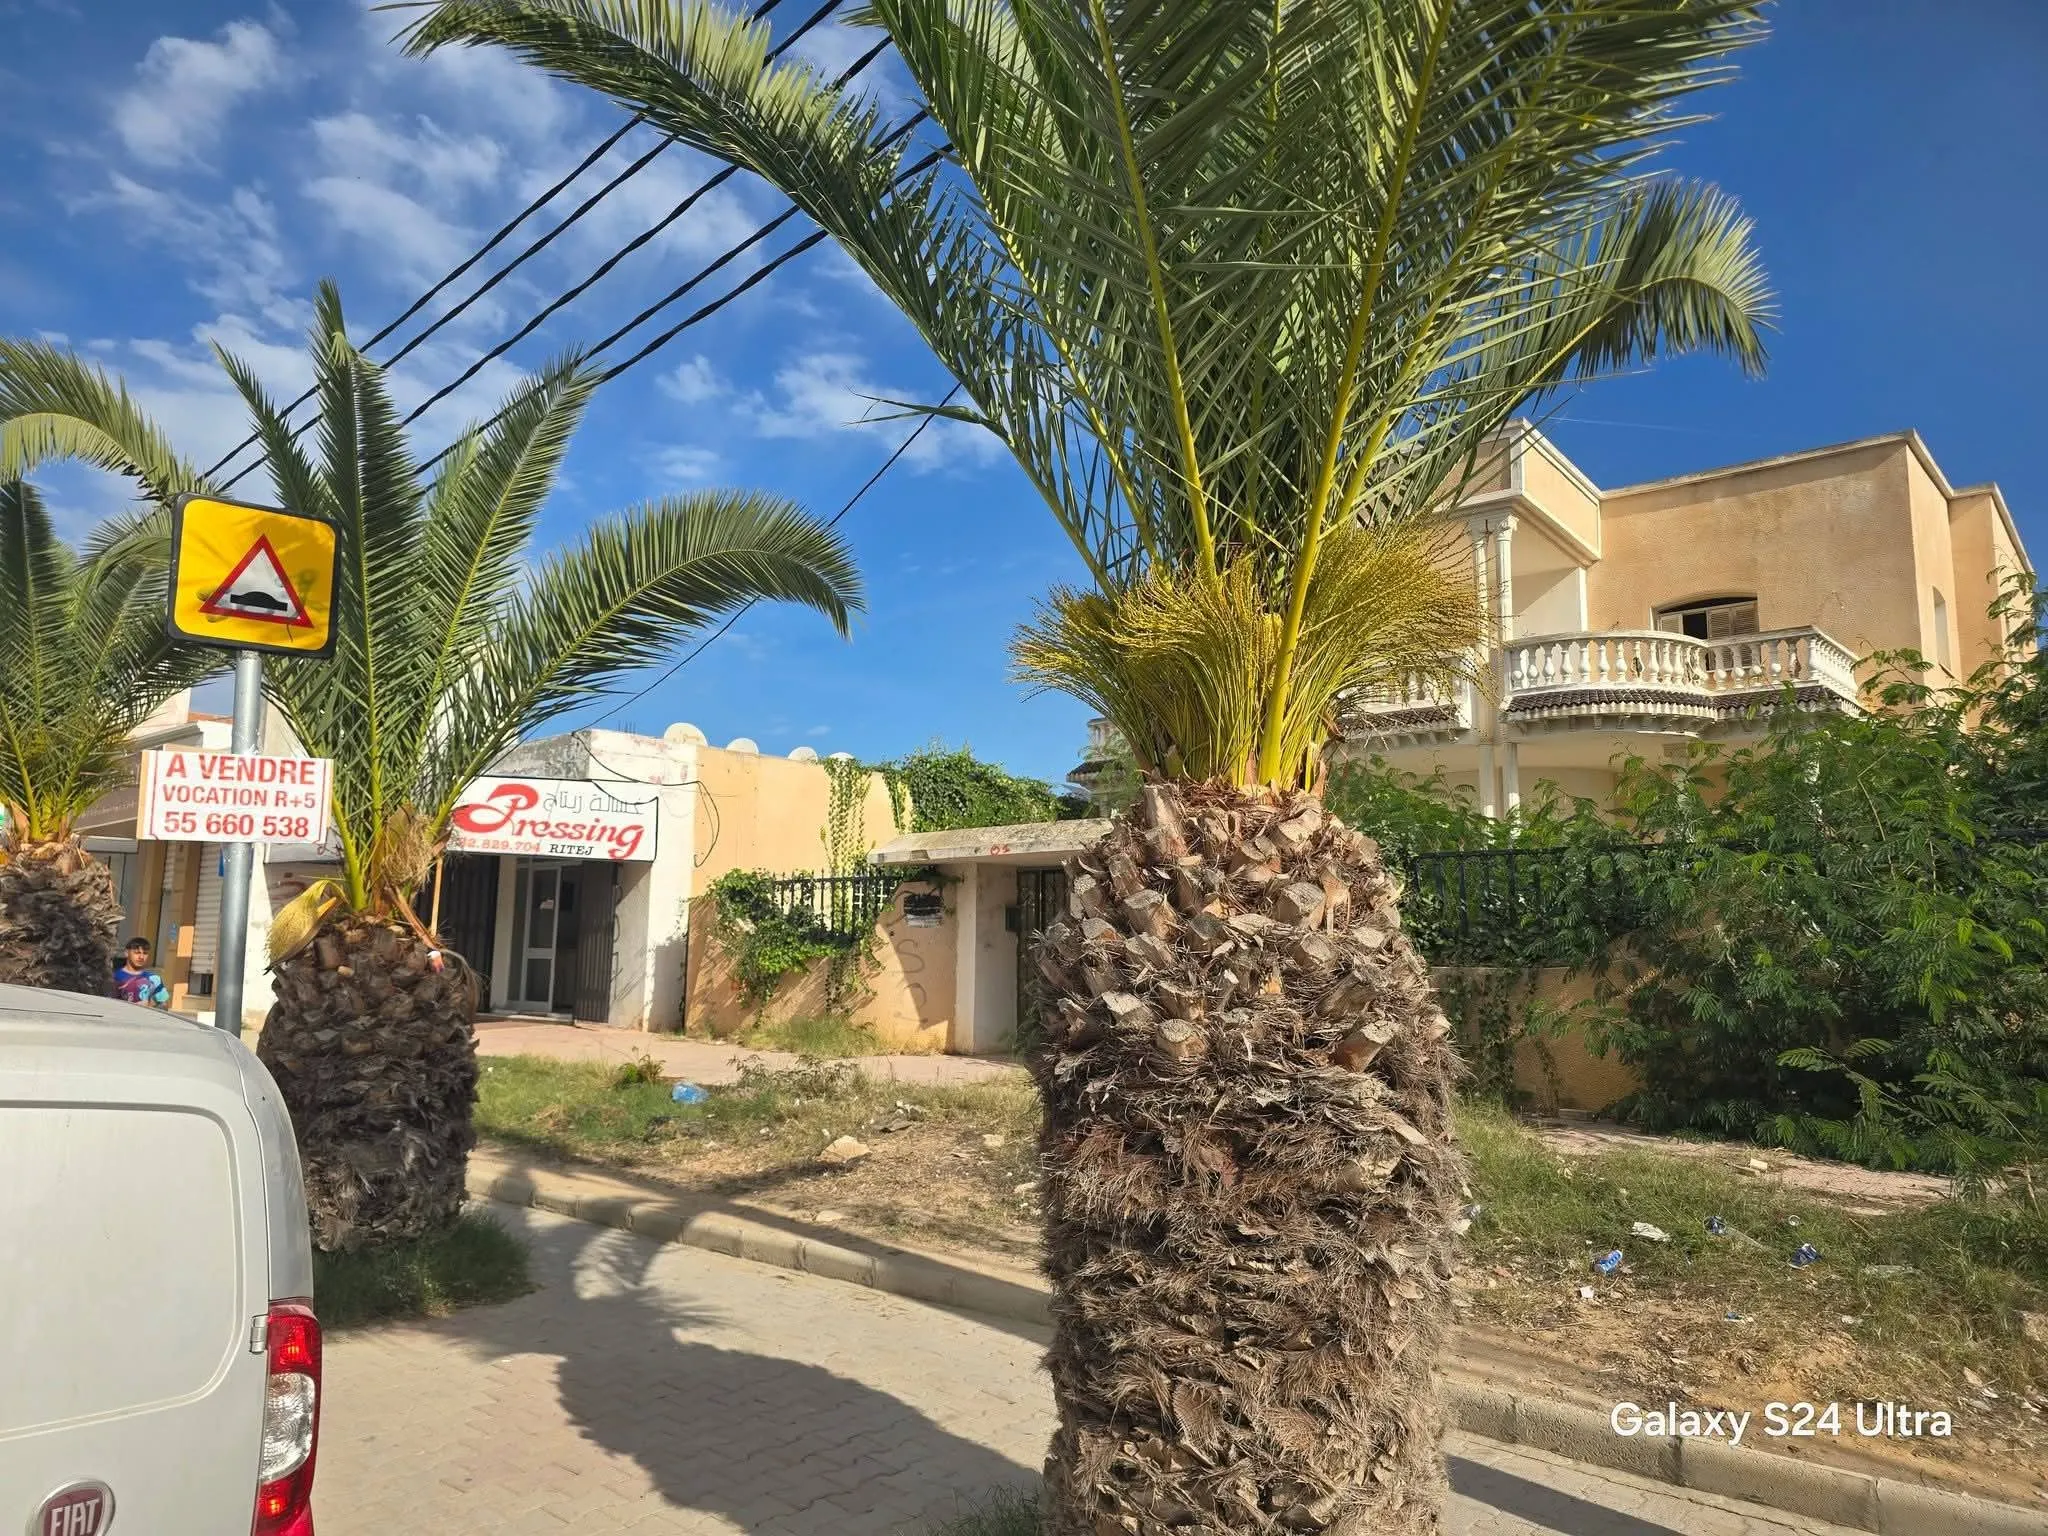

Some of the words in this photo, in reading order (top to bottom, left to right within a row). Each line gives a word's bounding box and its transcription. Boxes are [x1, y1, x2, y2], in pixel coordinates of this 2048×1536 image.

[166, 753, 187, 778] A
[199, 755, 315, 785] VENDRE
[163, 784, 267, 807] VOCATION
[275, 790, 316, 809] R+5
[164, 811, 197, 833] 55
[206, 814, 254, 836] 660
[262, 816, 309, 838] 538
[452, 783, 645, 860] Pressing
[549, 843, 594, 856] RITEJ
[50, 1498, 100, 1536] FIAT
